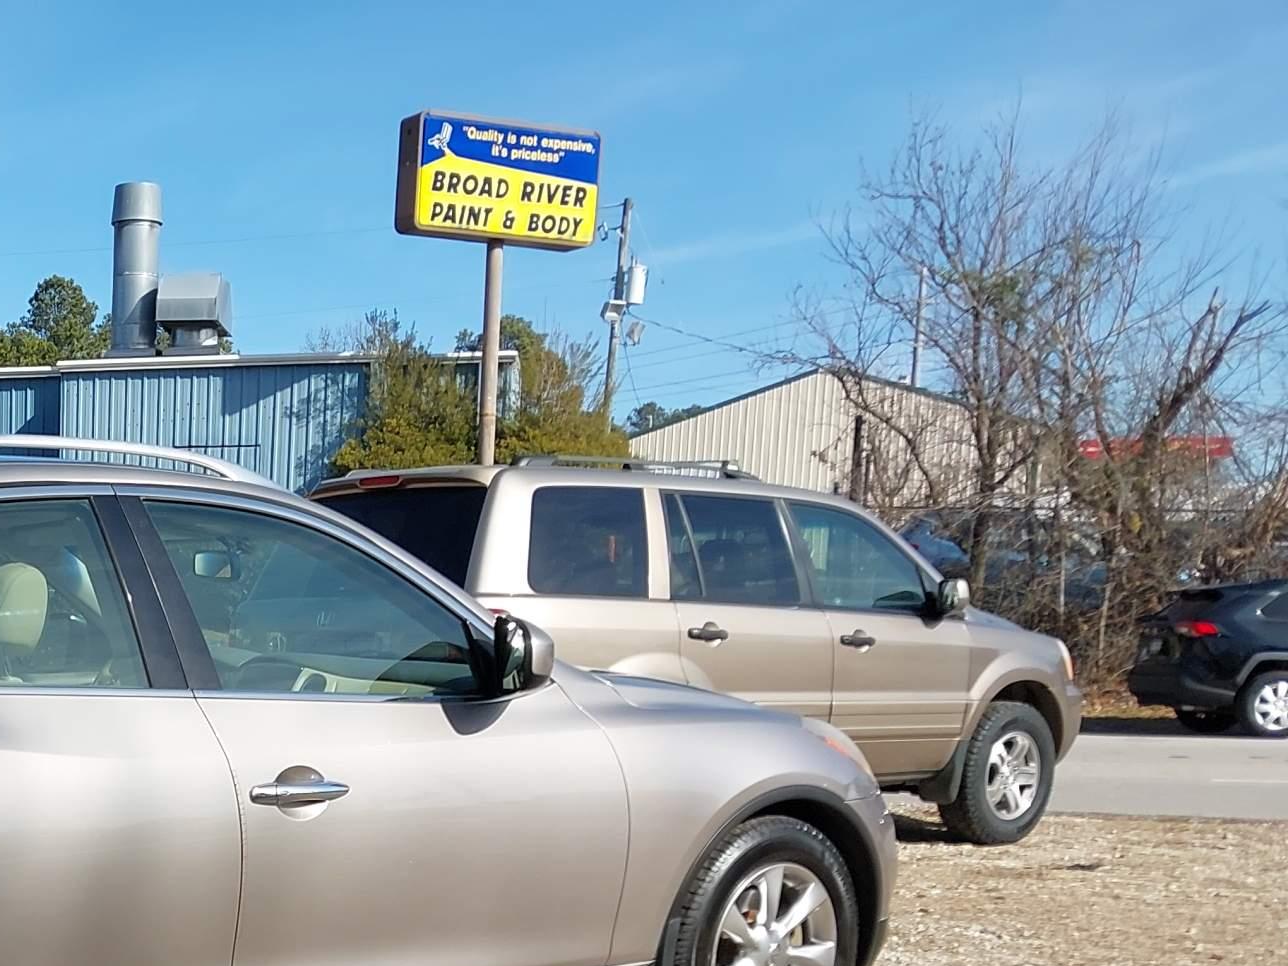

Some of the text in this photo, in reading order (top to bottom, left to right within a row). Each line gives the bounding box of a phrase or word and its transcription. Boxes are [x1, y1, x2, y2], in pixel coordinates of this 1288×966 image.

[463, 127, 595, 154] "Quality is not expensive,
[491, 145, 565, 163] it's priceless"
[432, 170, 588, 208] BROAD RIVER
[430, 202, 583, 236] PAINT & BODY
